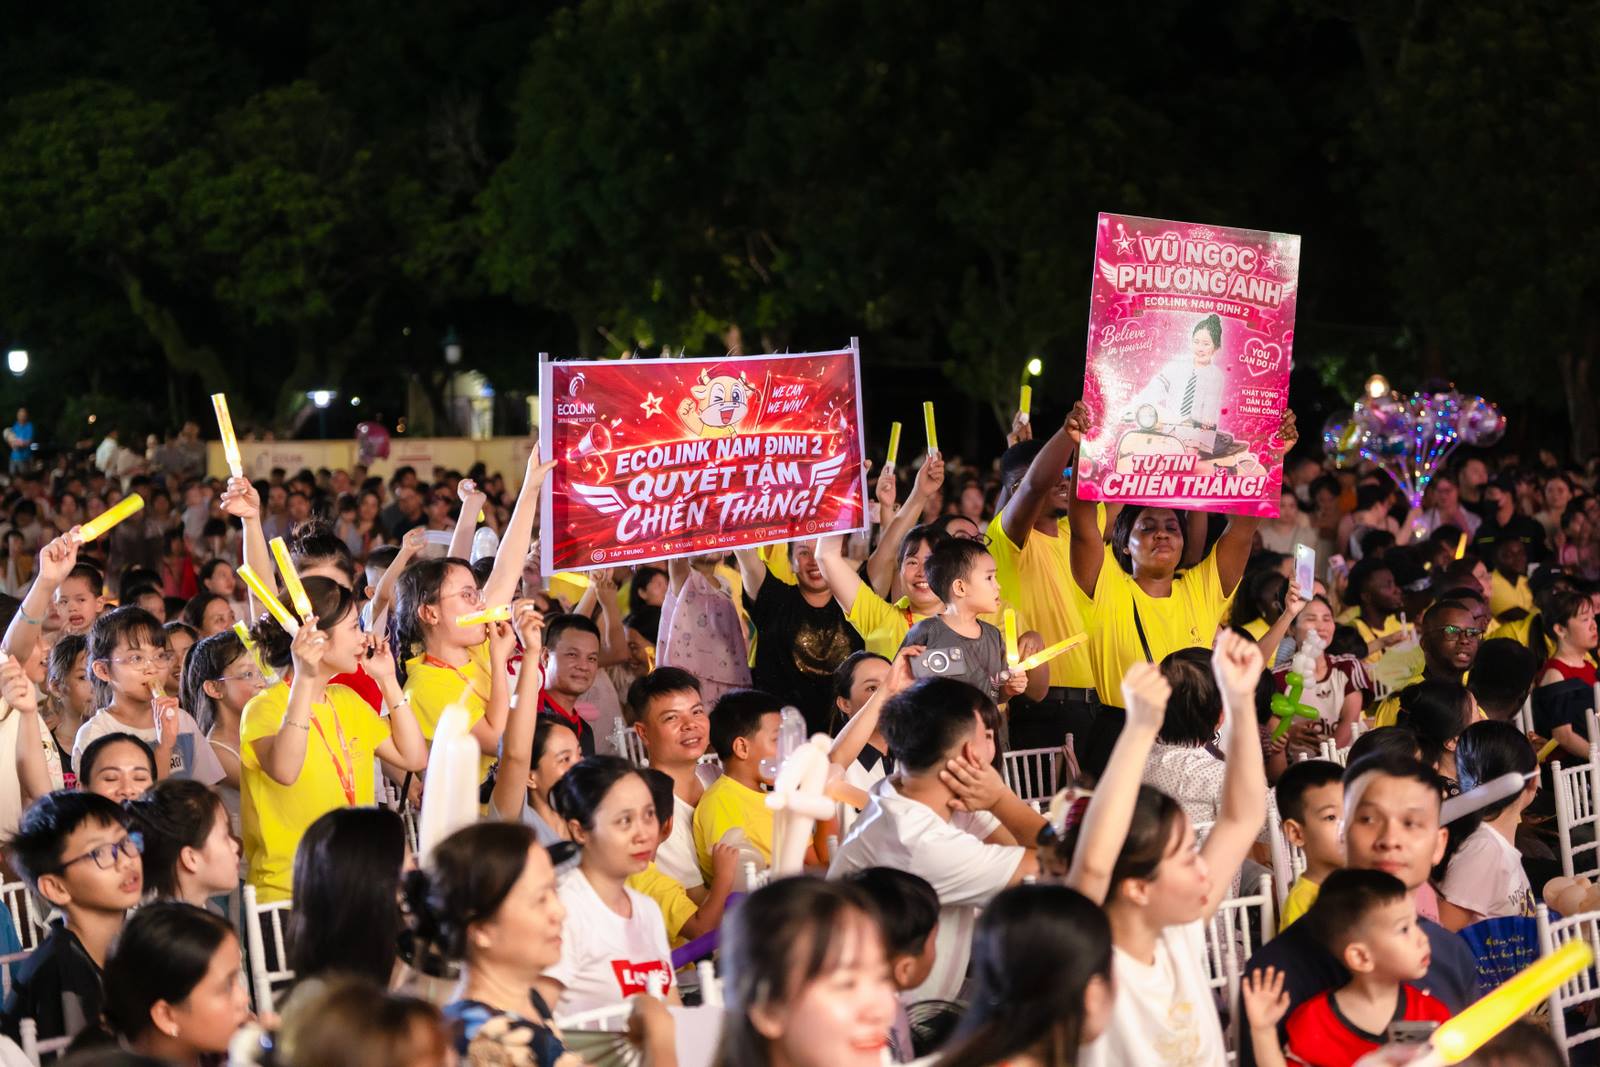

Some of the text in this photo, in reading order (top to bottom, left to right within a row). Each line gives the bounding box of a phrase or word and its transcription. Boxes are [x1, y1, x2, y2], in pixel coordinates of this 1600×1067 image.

[1142, 233, 1256, 273] VŨ NGỌC
[1118, 264, 1282, 305] PHƯƠNG ANH
[1144, 296, 1188, 308] ECOLINK
[1191, 298, 1214, 310] NAM
[1242, 307, 1249, 317] 2
[1100, 321, 1146, 347] Believe
[1108, 337, 1153, 359] in yourself
[1252, 347, 1270, 360] YOU
[1239, 354, 1279, 371] CAN DO IT!
[772, 383, 804, 398] WE CAN
[557, 402, 596, 415] ECOLINK
[767, 395, 809, 413] WE WIN!
[615, 440, 712, 475] ECOLINK
[716, 437, 761, 459] NAM
[811, 434, 822, 455] 2
[1163, 455, 1195, 471] TIN
[627, 459, 736, 501] QUYẾT
[1103, 468, 1266, 497] CHIẾN THẮNG!
[616, 491, 709, 543] CHIẾN
